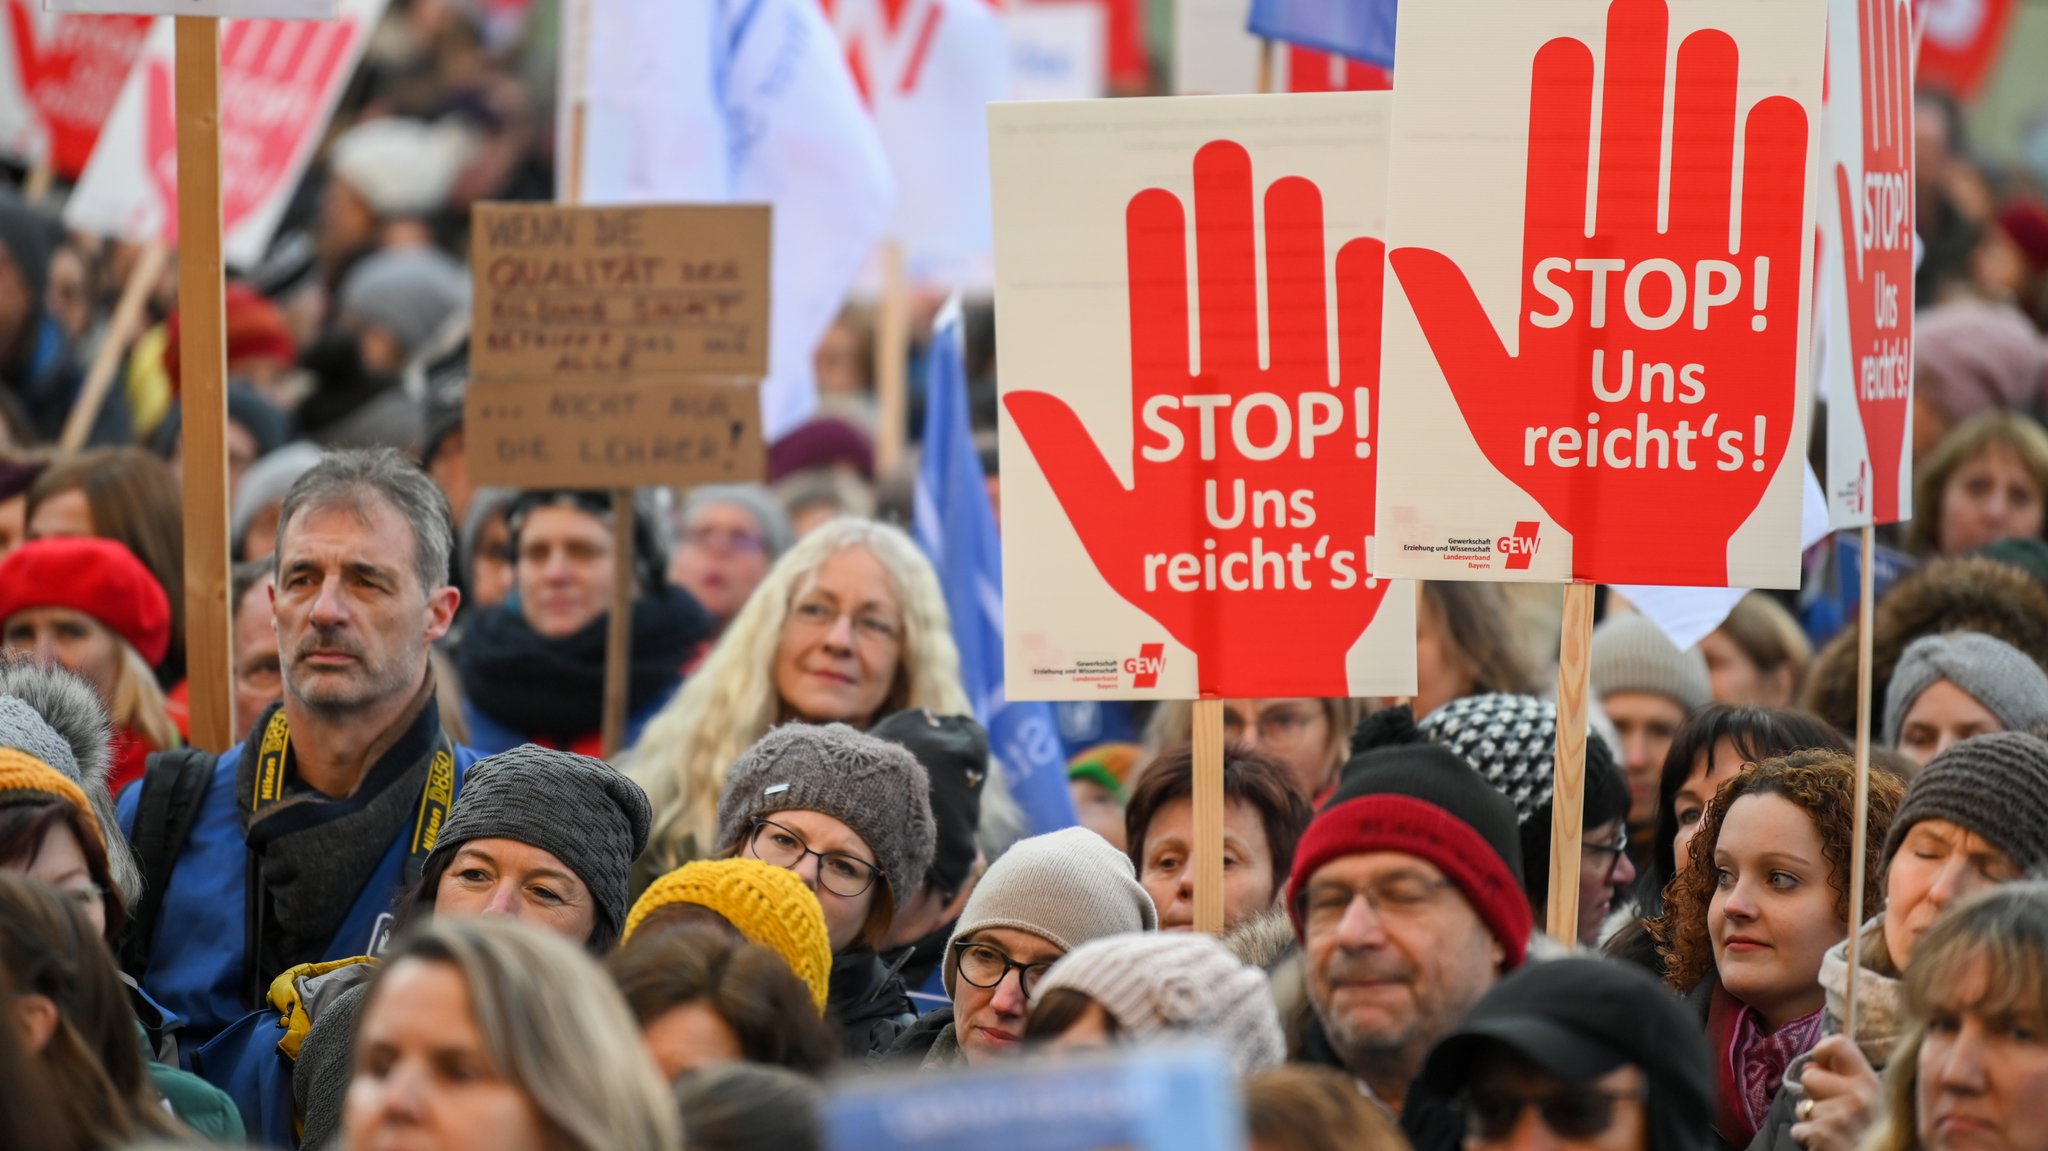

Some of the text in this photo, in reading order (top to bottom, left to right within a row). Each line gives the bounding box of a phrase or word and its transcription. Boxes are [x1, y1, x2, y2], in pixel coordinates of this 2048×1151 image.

[1863, 169, 1909, 250] STOP!
[486, 213, 575, 247] WENN
[487, 253, 664, 290] QUALITÄT
[1530, 256, 1770, 332] STOP!
[1874, 271, 1899, 329] Uns
[1592, 349, 1706, 404] Uns
[550, 393, 639, 418] NICHT
[1142, 386, 1371, 462] STOP!
[496, 437, 549, 461] DIE
[1524, 412, 1766, 472] reicht‘s!
[1205, 478, 1316, 530] Uns
[1403, 544, 1434, 552] Erziehung
[1449, 545, 1490, 553] Wissenschaft
[1442, 553, 1490, 561] Landesverband
[1447, 537, 1491, 545] Gewerkschaft
[1497, 536, 1540, 554] GEW
[1467, 561, 1490, 570] Bayern
[1124, 658, 1166, 675] GEW
[261, 757, 277, 800] Nikon
[423, 750, 450, 852] Nikon D850
